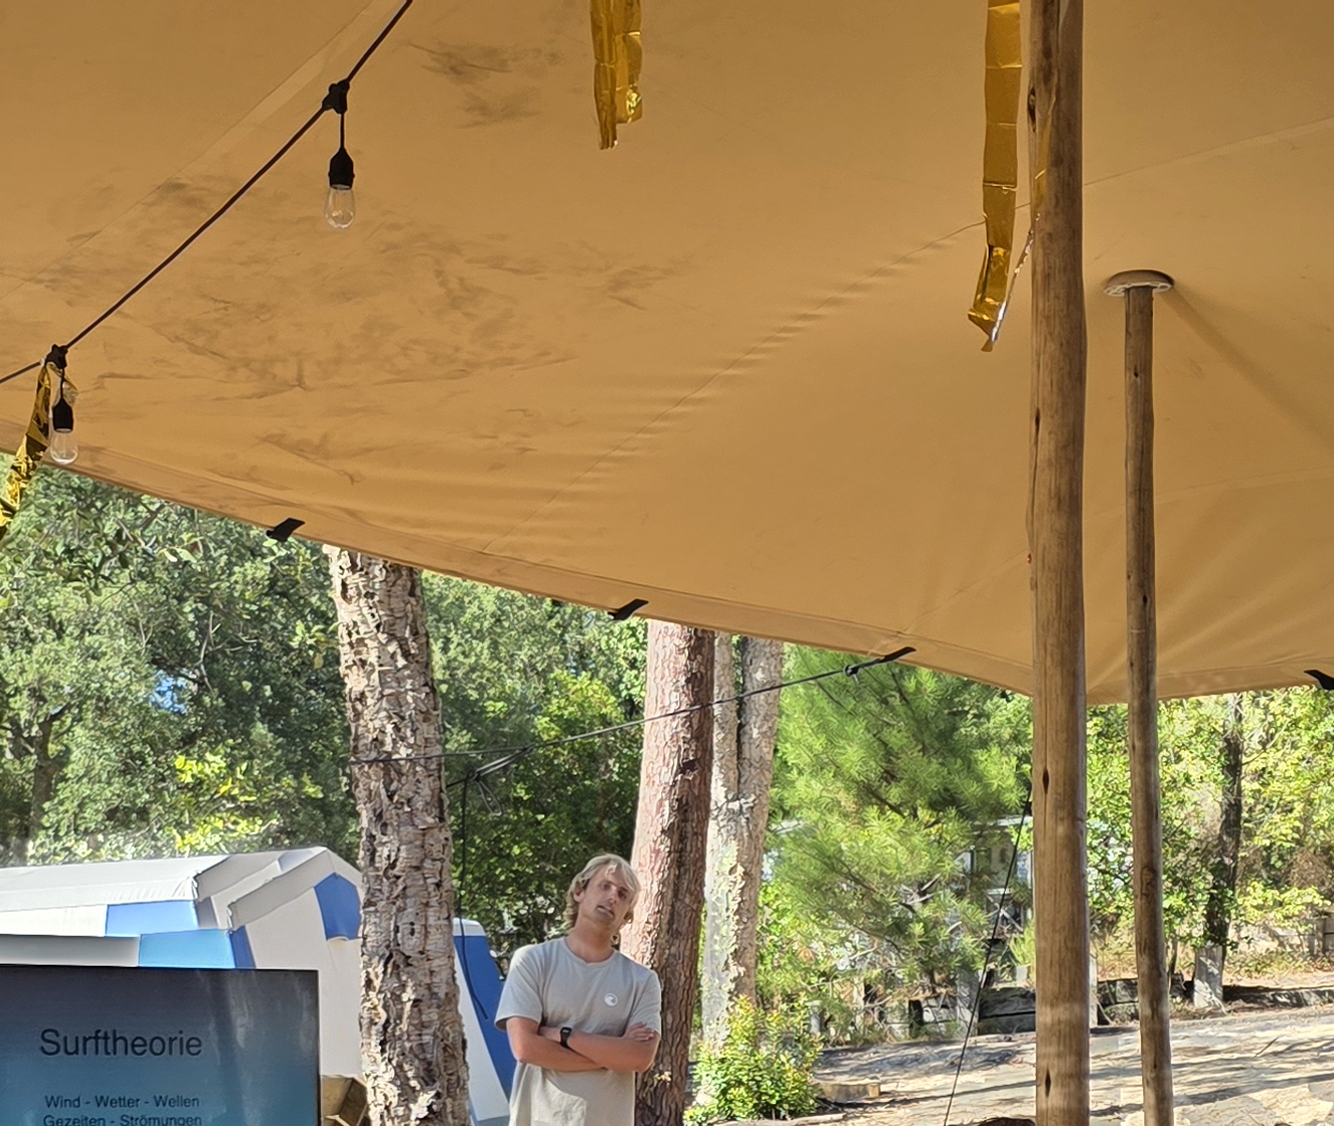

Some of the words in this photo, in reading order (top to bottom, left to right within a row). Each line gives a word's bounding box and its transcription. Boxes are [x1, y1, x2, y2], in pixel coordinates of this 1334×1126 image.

[40, 1028, 202, 1056] Surftheorie
[44, 1095, 81, 1108] Wind
[94, 1095, 141, 1108] Wetter
[153, 1095, 200, 1108] Wellen
